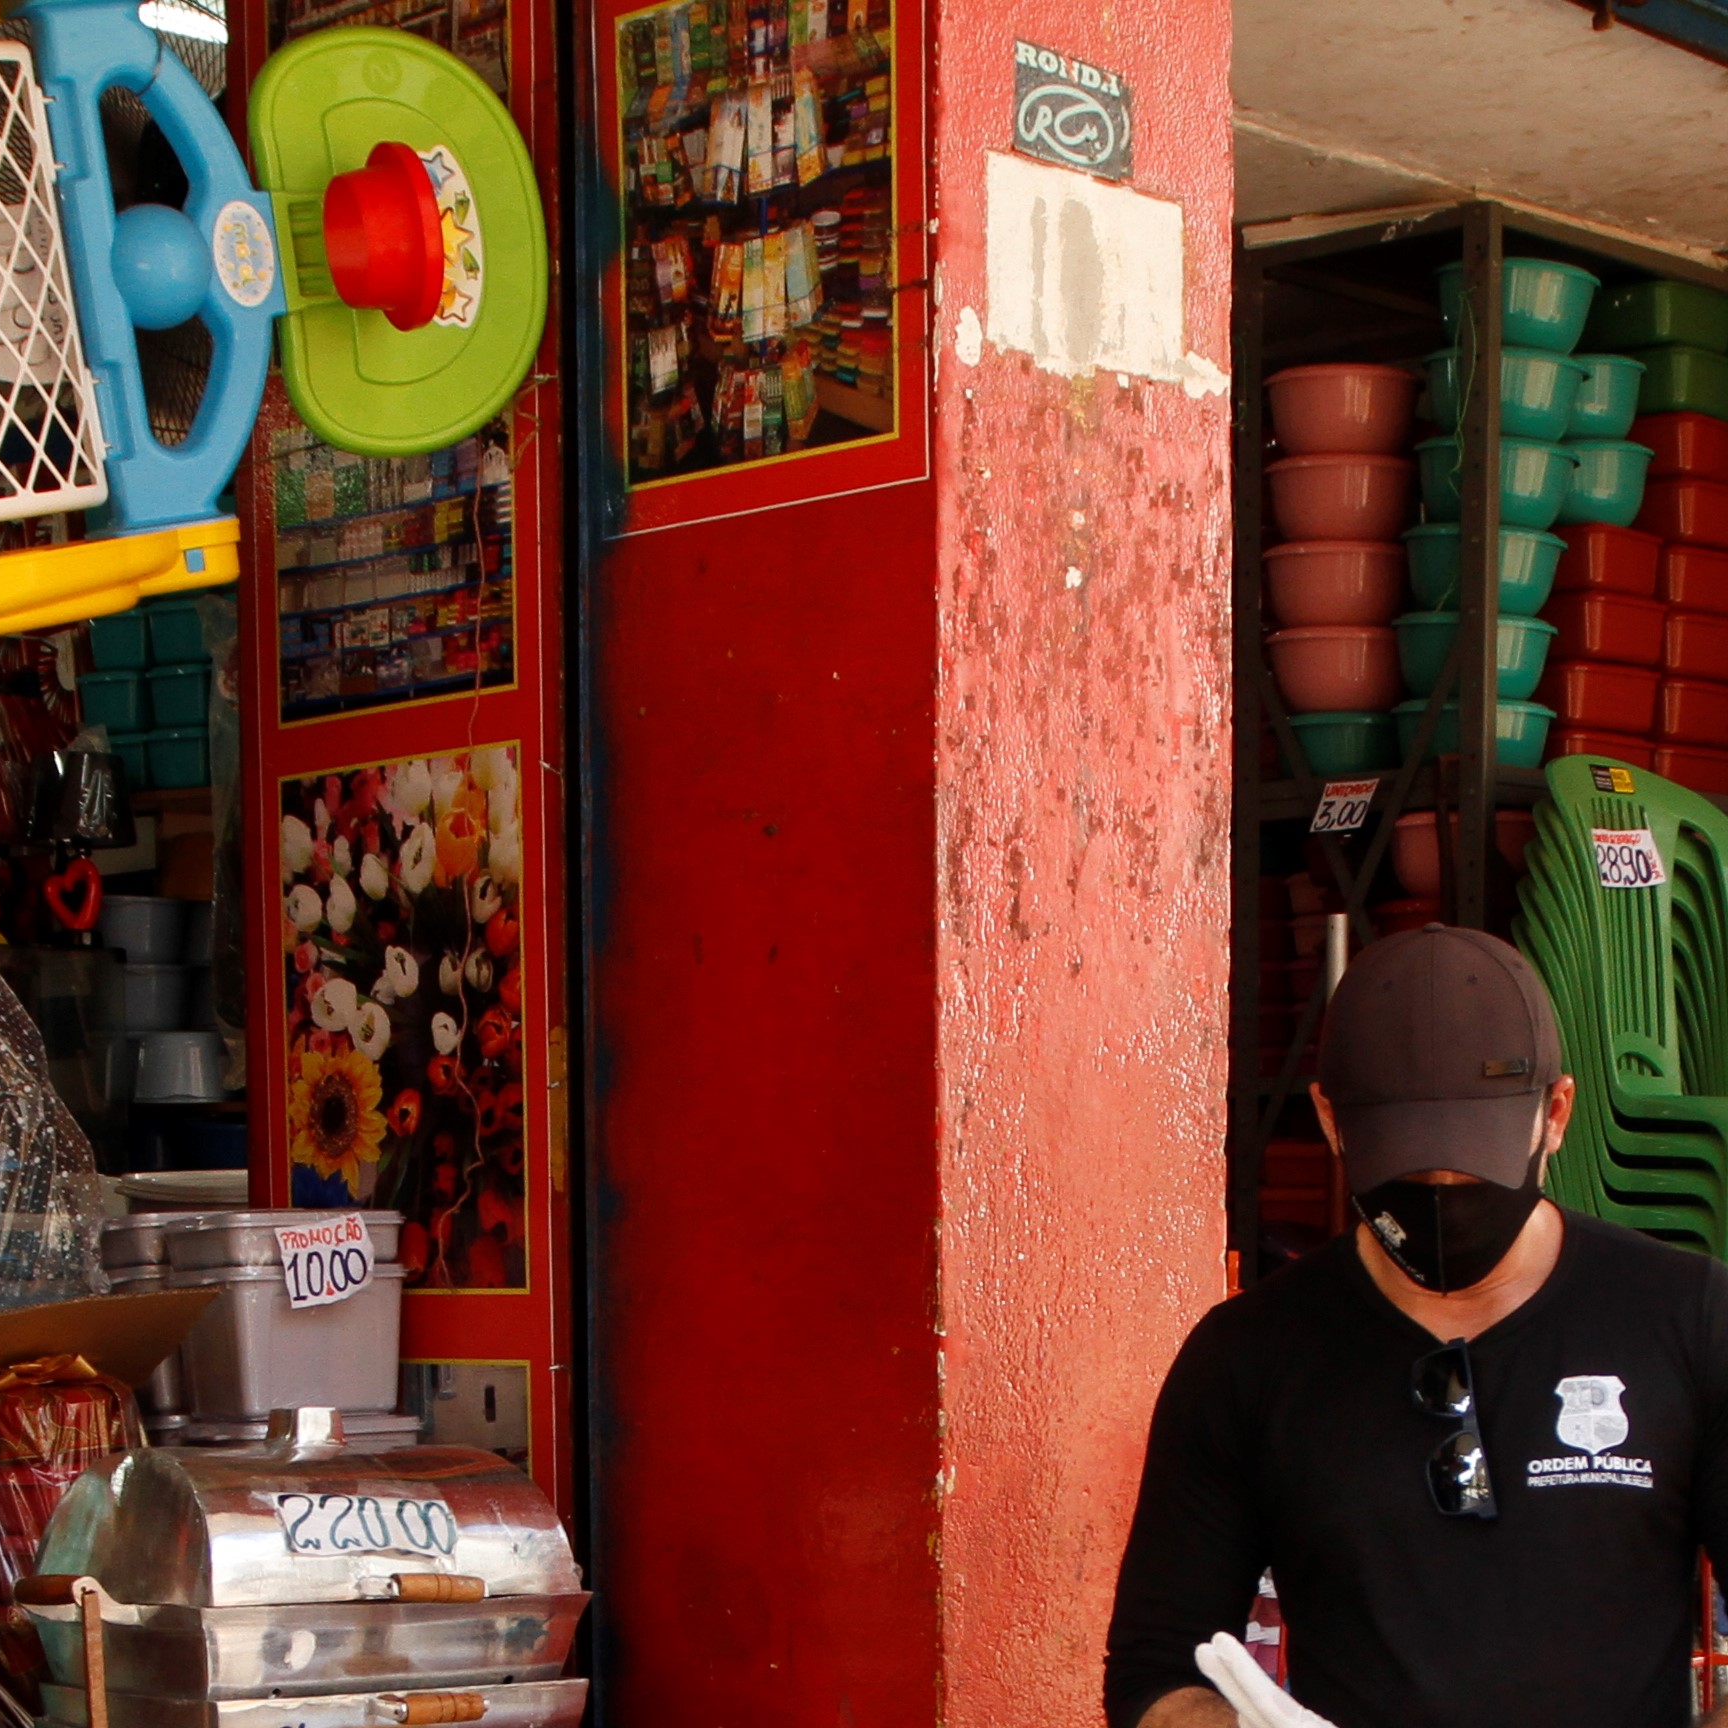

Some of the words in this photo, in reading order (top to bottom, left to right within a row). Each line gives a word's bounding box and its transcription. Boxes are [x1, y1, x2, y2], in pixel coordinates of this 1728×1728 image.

[1015, 40, 1121, 97] RONDA
[1314, 800, 1368, 831] 3,00
[280, 1217, 363, 1250] PROMOÇÃO
[1527, 1456, 1589, 1474] ORDEM
[1593, 1452, 1652, 1473] PÚBLICA
